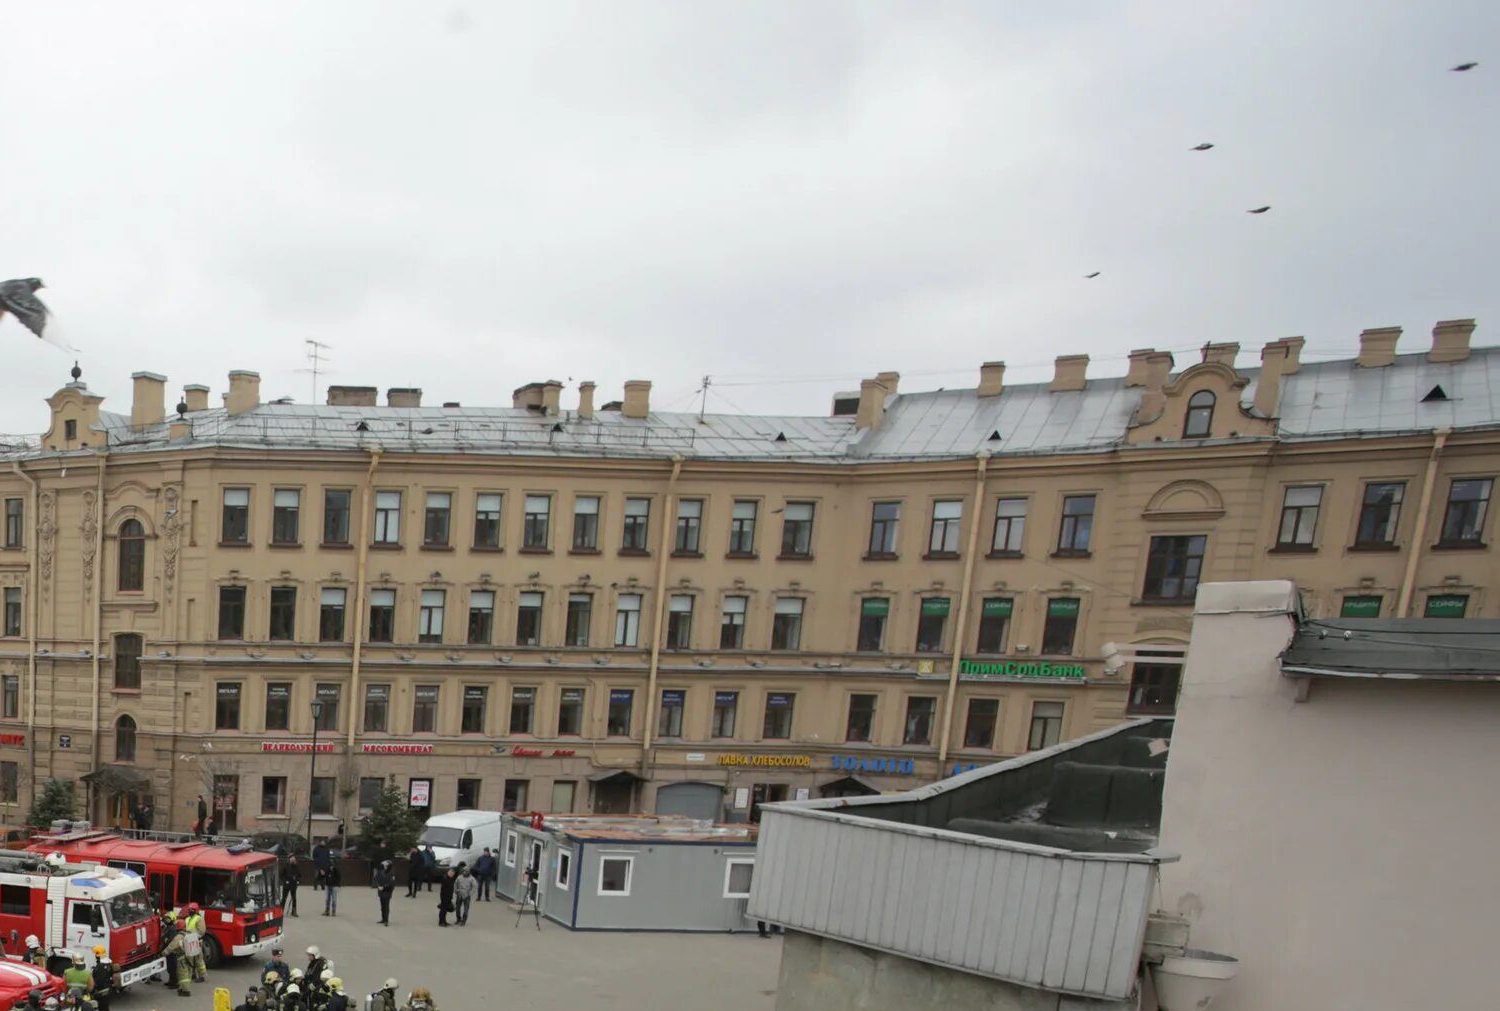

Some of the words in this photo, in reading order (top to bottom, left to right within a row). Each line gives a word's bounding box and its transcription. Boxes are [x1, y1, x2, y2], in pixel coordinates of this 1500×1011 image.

[960, 659, 1085, 678] ПримСоцБанк
[263, 741, 335, 752] ВЕЛИКОЛУКСКИЙ
[362, 744, 434, 753] МЯСОКОМБИНАТ
[718, 754, 749, 766] ЛАВКА
[750, 755, 811, 767] ХЛЕБОСОЛОВ
[832, 754, 915, 775] ЗОЛОТО
[76, 930, 85, 944] 7
